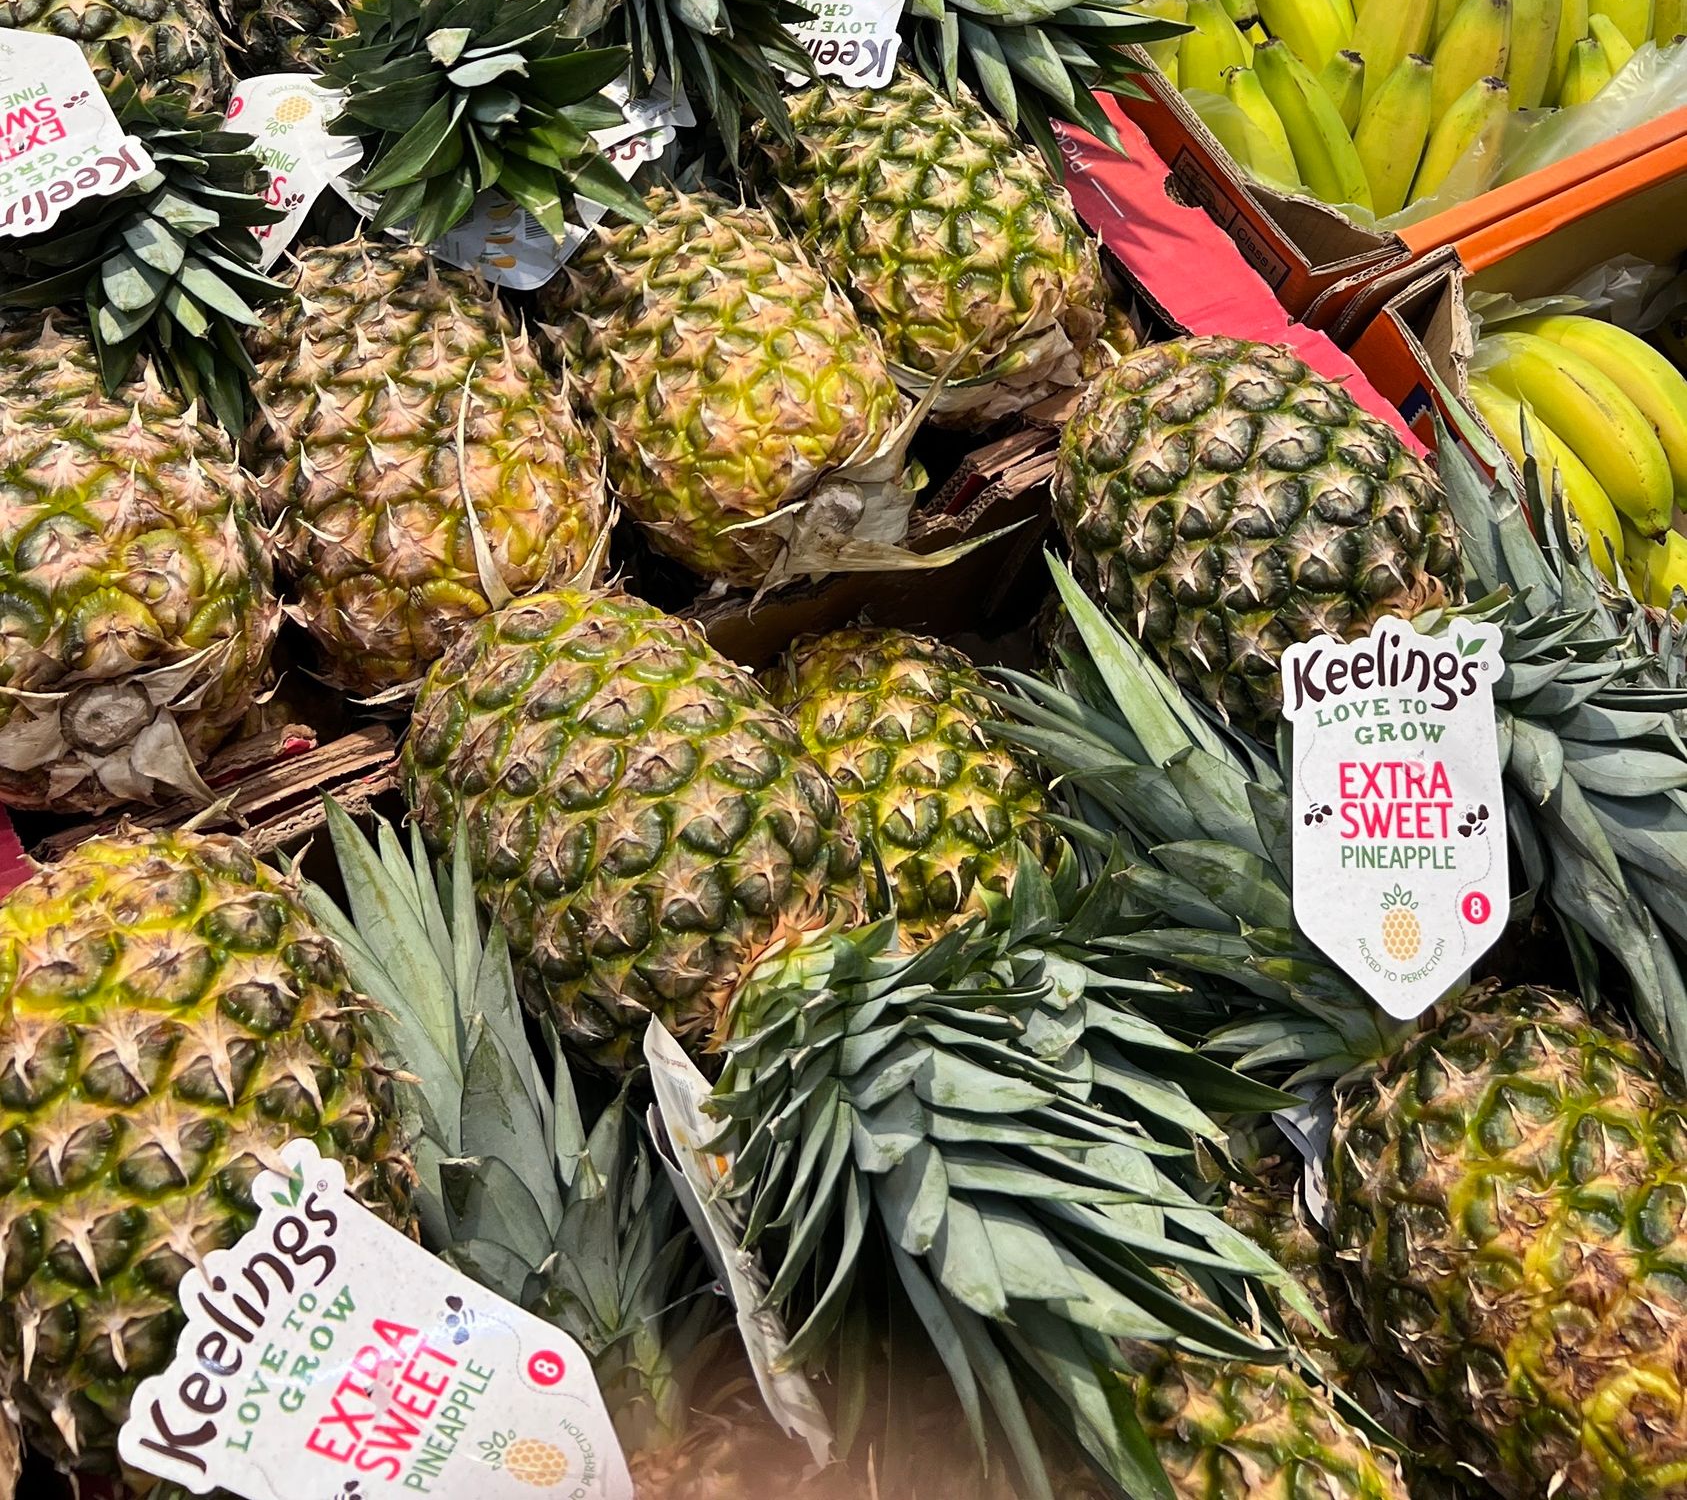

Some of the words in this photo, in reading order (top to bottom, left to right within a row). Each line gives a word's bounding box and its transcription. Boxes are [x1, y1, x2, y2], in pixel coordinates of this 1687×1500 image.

[821, 21, 877, 34] LOVE
[28, 145, 103, 188] LOVE
[1048, 117, 1094, 174] Picke
[0, 152, 58, 186] GRO
[1236, 228, 1270, 267] Class
[1293, 630, 1479, 711] Keelings
[1315, 698, 1390, 728] LOVE
[1400, 699, 1427, 715] TO
[1354, 722, 1446, 744] GROW
[1339, 761, 1453, 799] EXTRA
[1340, 802, 1453, 839] SWEET
[1341, 845, 1457, 870] PINEAPPLE
[1470, 897, 1483, 919] 8
[1358, 937, 1381, 973] PICKED
[1384, 969, 1397, 982] TO
[1401, 937, 1446, 983] PERFECTION
[139, 1192, 338, 1475] Keelings
[279, 1284, 357, 1413] GROW
[226, 1342, 289, 1454] LOVE
[282, 1292, 318, 1332] TO
[305, 1318, 420, 1463] EXTRA
[354, 1335, 459, 1482] SWEET
[403, 1358, 495, 1494] PINEAPPLE
[560, 1417, 595, 1487] PERFECTION
